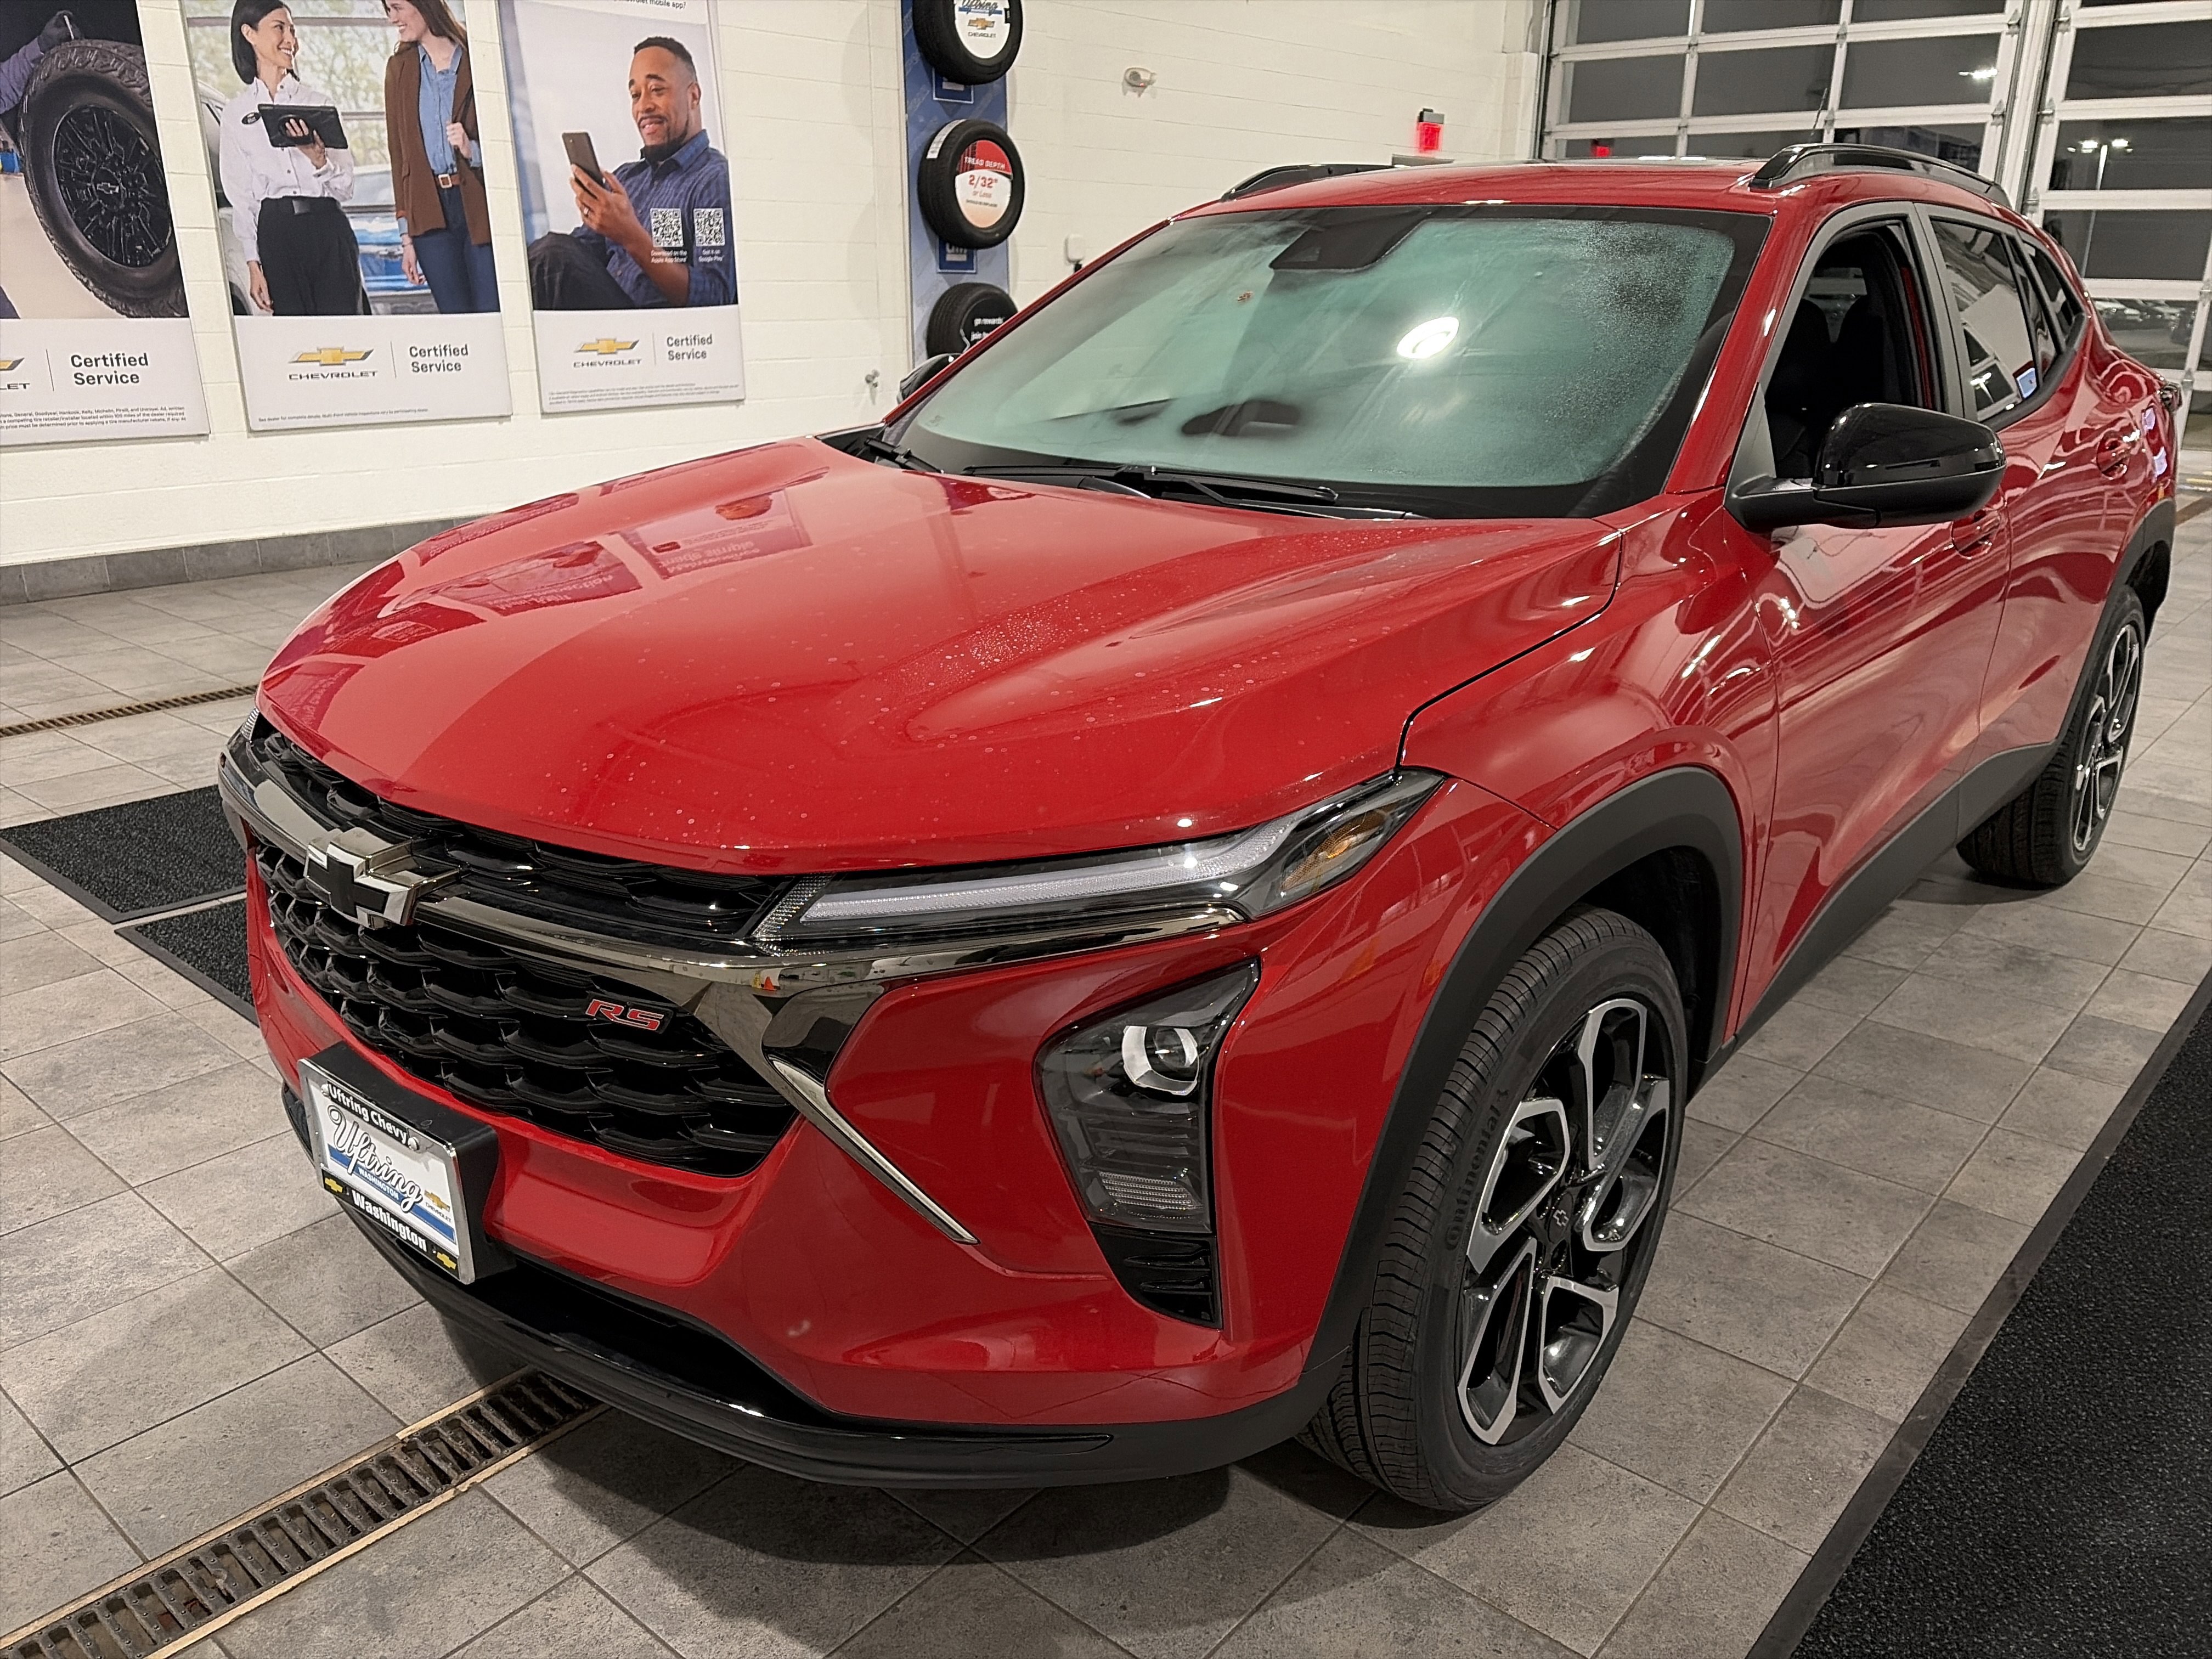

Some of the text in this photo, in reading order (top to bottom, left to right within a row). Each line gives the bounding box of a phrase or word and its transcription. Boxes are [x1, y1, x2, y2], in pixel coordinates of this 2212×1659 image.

[964, 156, 984, 166] TREAD
[667, 334, 713, 347] Certified
[409, 344, 469, 357] Certified
[668, 349, 707, 361] Service
[71, 353, 149, 368] Certified
[411, 360, 461, 374] Service
[573, 358, 642, 368] CHEVROLET
[74, 370, 139, 385] Service
[289, 370, 378, 381] CHEVROLET
[585, 998, 664, 1031] RS
[329, 1084, 407, 1144] Uftring Chevy
[328, 1104, 423, 1213] Uftring
[358, 1166, 399, 1200] WASHINGTON
[1444, 1104, 1501, 1251] Continental
[425, 1201, 451, 1223] CHEVROLET
[352, 1190, 427, 1252] Washington
